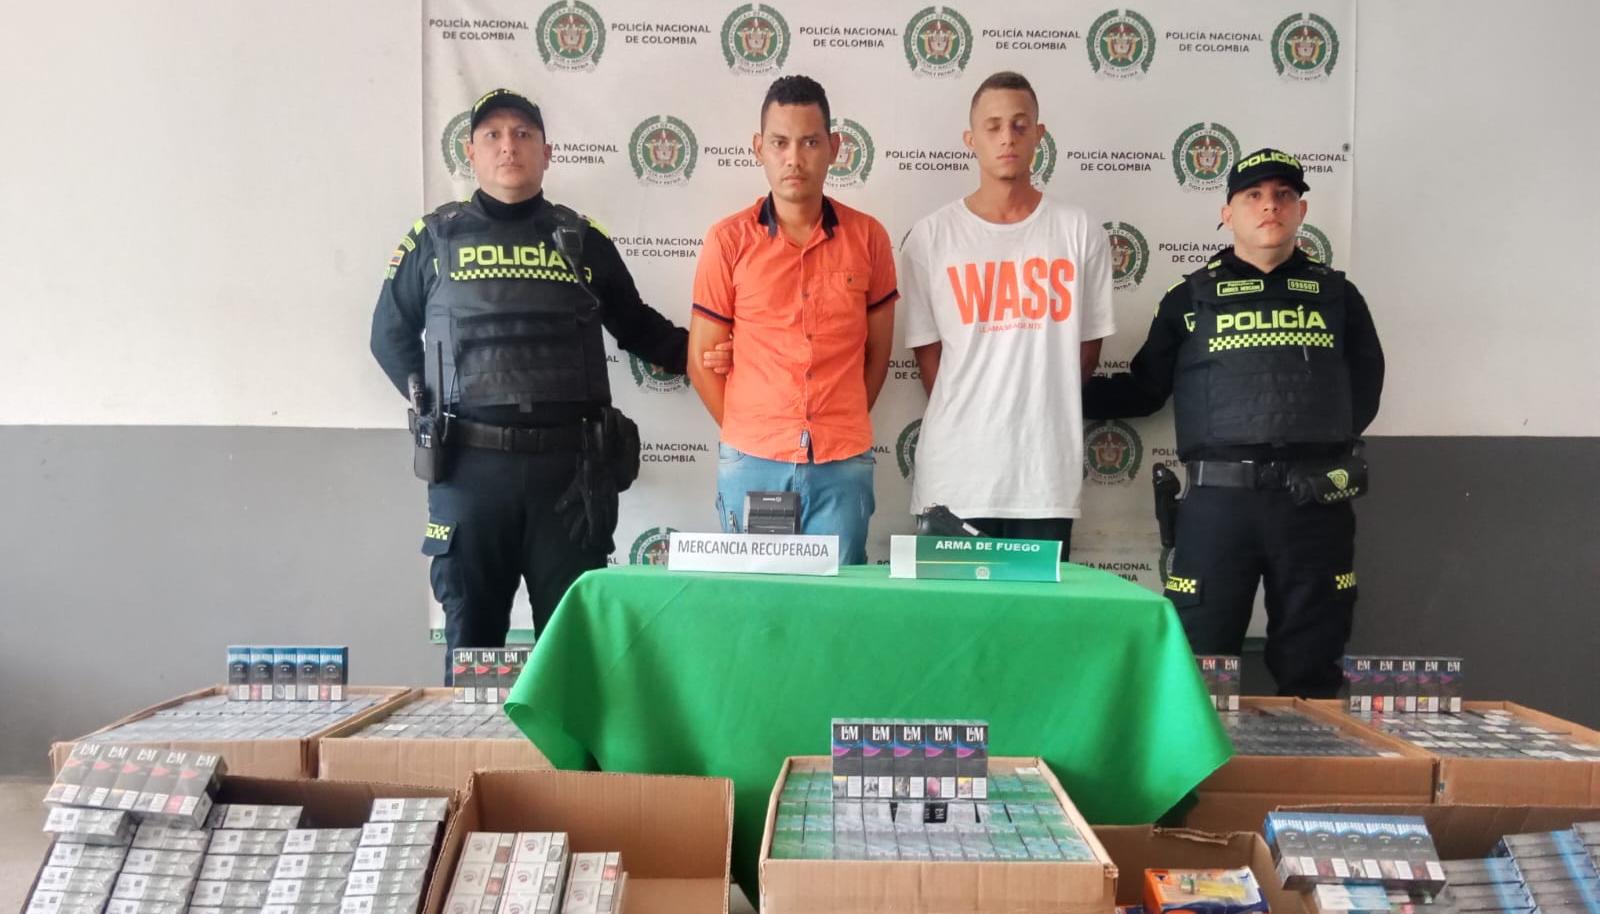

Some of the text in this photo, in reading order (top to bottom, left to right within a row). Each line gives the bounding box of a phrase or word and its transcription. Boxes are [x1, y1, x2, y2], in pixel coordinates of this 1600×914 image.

[429, 18, 529, 30] POLICÍA NACIONAL
[611, 22, 711, 34] POLICÍA NACIONAL
[442, 31, 515, 41] DE COLOMBIA
[799, 25, 898, 37] POLICÍA NACIONAL
[982, 28, 1081, 39] POLICÍA NACIONAL
[1165, 30, 1264, 42] POLICÍA NACIONAL
[625, 35, 698, 45] DE COLOMBIA
[813, 38, 885, 48] DE COLOMBIA
[996, 41, 1067, 51] DE COLOMBIA
[1179, 43, 1250, 53] DE COLOMBIA
[563, 143, 619, 152] NACIONAL
[704, 145, 746, 155] POLICÍA
[550, 155, 605, 164] COLOMBIA
[885, 149, 977, 160] POLICÍA NACIONA
[1067, 150, 1166, 162] POLICÍA NACIONAL
[1294, 153, 1347, 162] NACIONAL
[718, 158, 731, 167] DE
[898, 162, 970, 172] DE COLOMBIA
[1080, 163, 1152, 173] DE COLOMBIA
[1303, 165, 1334, 173] OMBIA
[656, 237, 704, 247] NACIONA
[1159, 242, 1200, 252] POLICÍA
[458, 242, 568, 270] POLICÍA
[626, 249, 697, 258] DE COLOMBIA
[1172, 255, 1185, 263] DE
[946, 257, 1075, 325] WASS
[1216, 304, 1327, 333] POLICÍA
[656, 443, 709, 452] NACIONAL
[1152, 448, 1175, 456] POLI
[642, 454, 696, 463] COLOMBIA
[677, 539, 829, 557] MERCANCIA RECUPERADA
[935, 540, 1040, 552] ARMA DE FUEGO
[1098, 562, 1152, 571] NACIONAL
